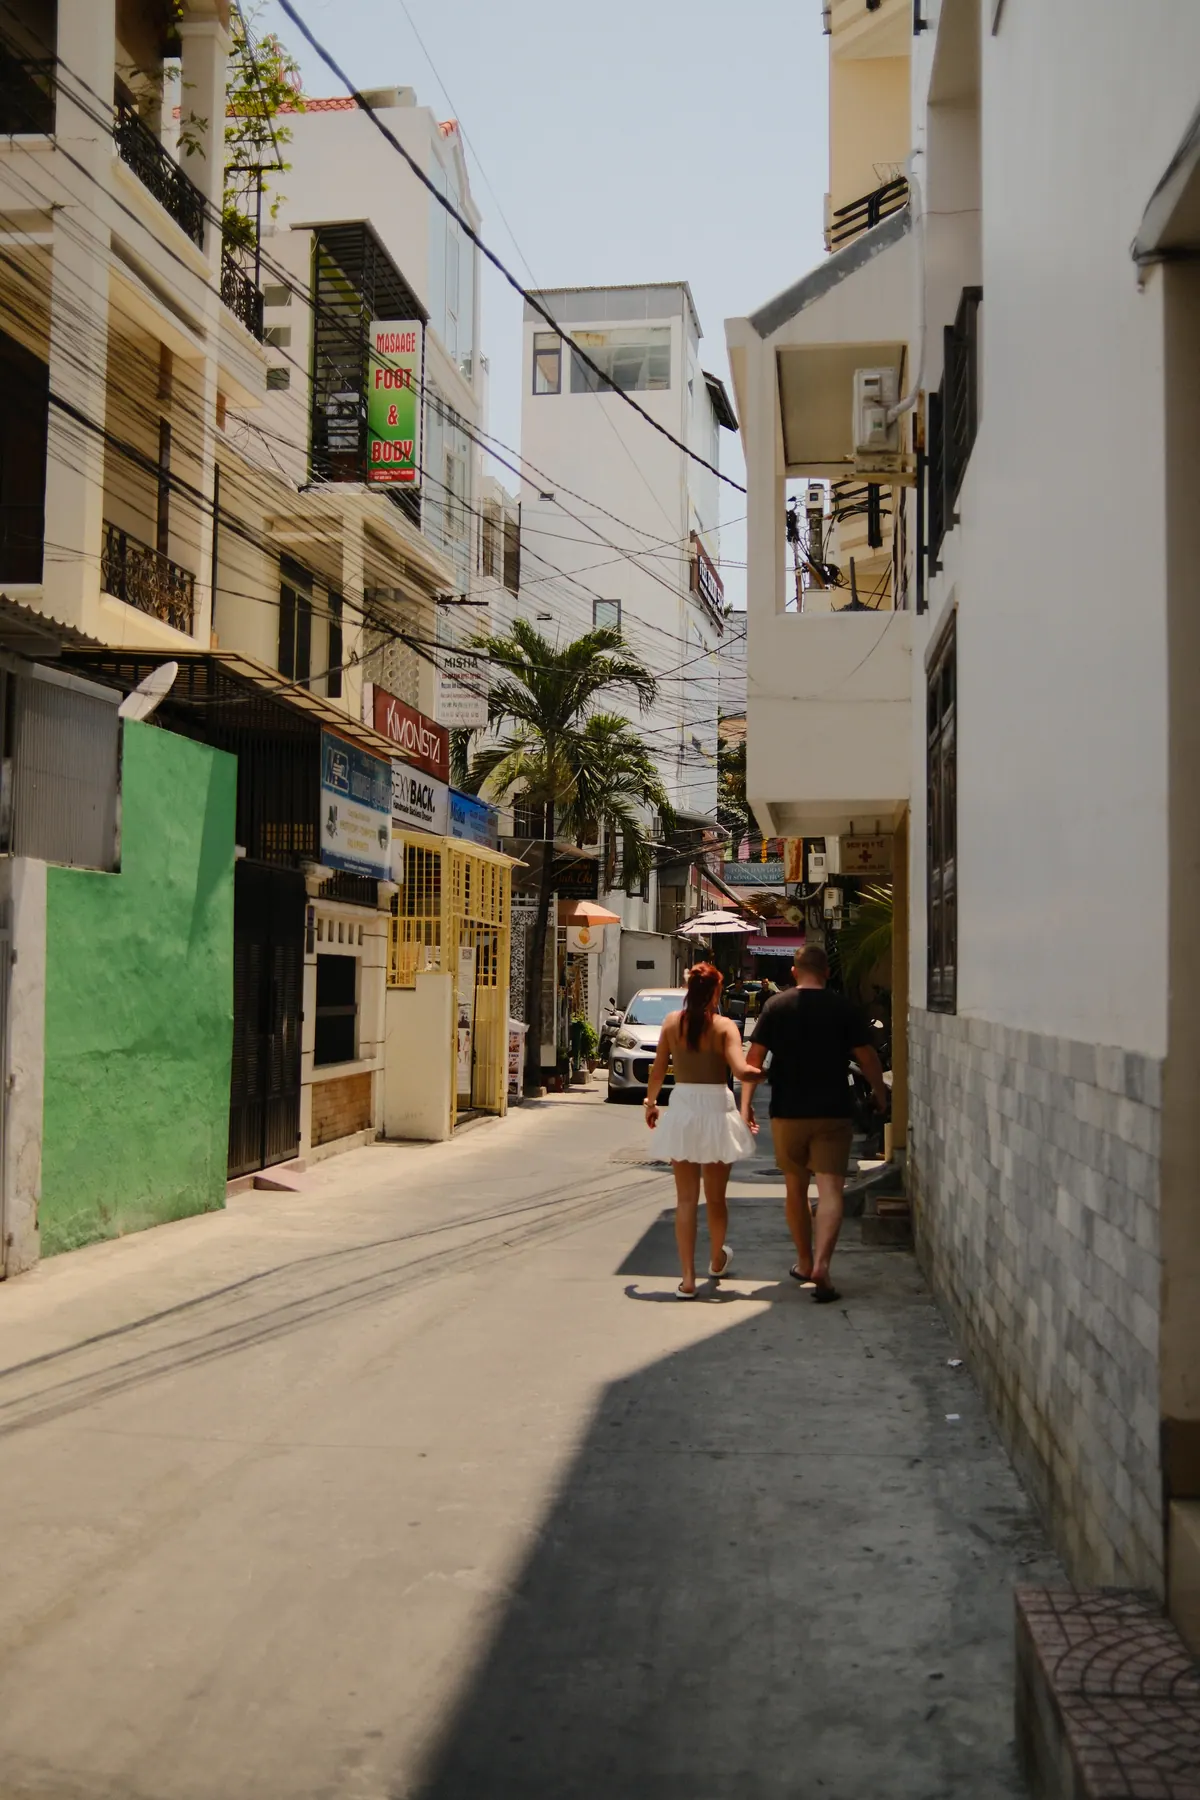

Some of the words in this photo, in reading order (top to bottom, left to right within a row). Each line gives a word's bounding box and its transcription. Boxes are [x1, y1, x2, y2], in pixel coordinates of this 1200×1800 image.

[376, 332, 416, 354] MASAAGE
[375, 368, 413, 390] FOOT
[387, 404, 398, 426] &
[371, 440, 414, 463] BODY
[444, 657, 479, 669] MISHA
[387, 699, 440, 764] KIMONISTA
